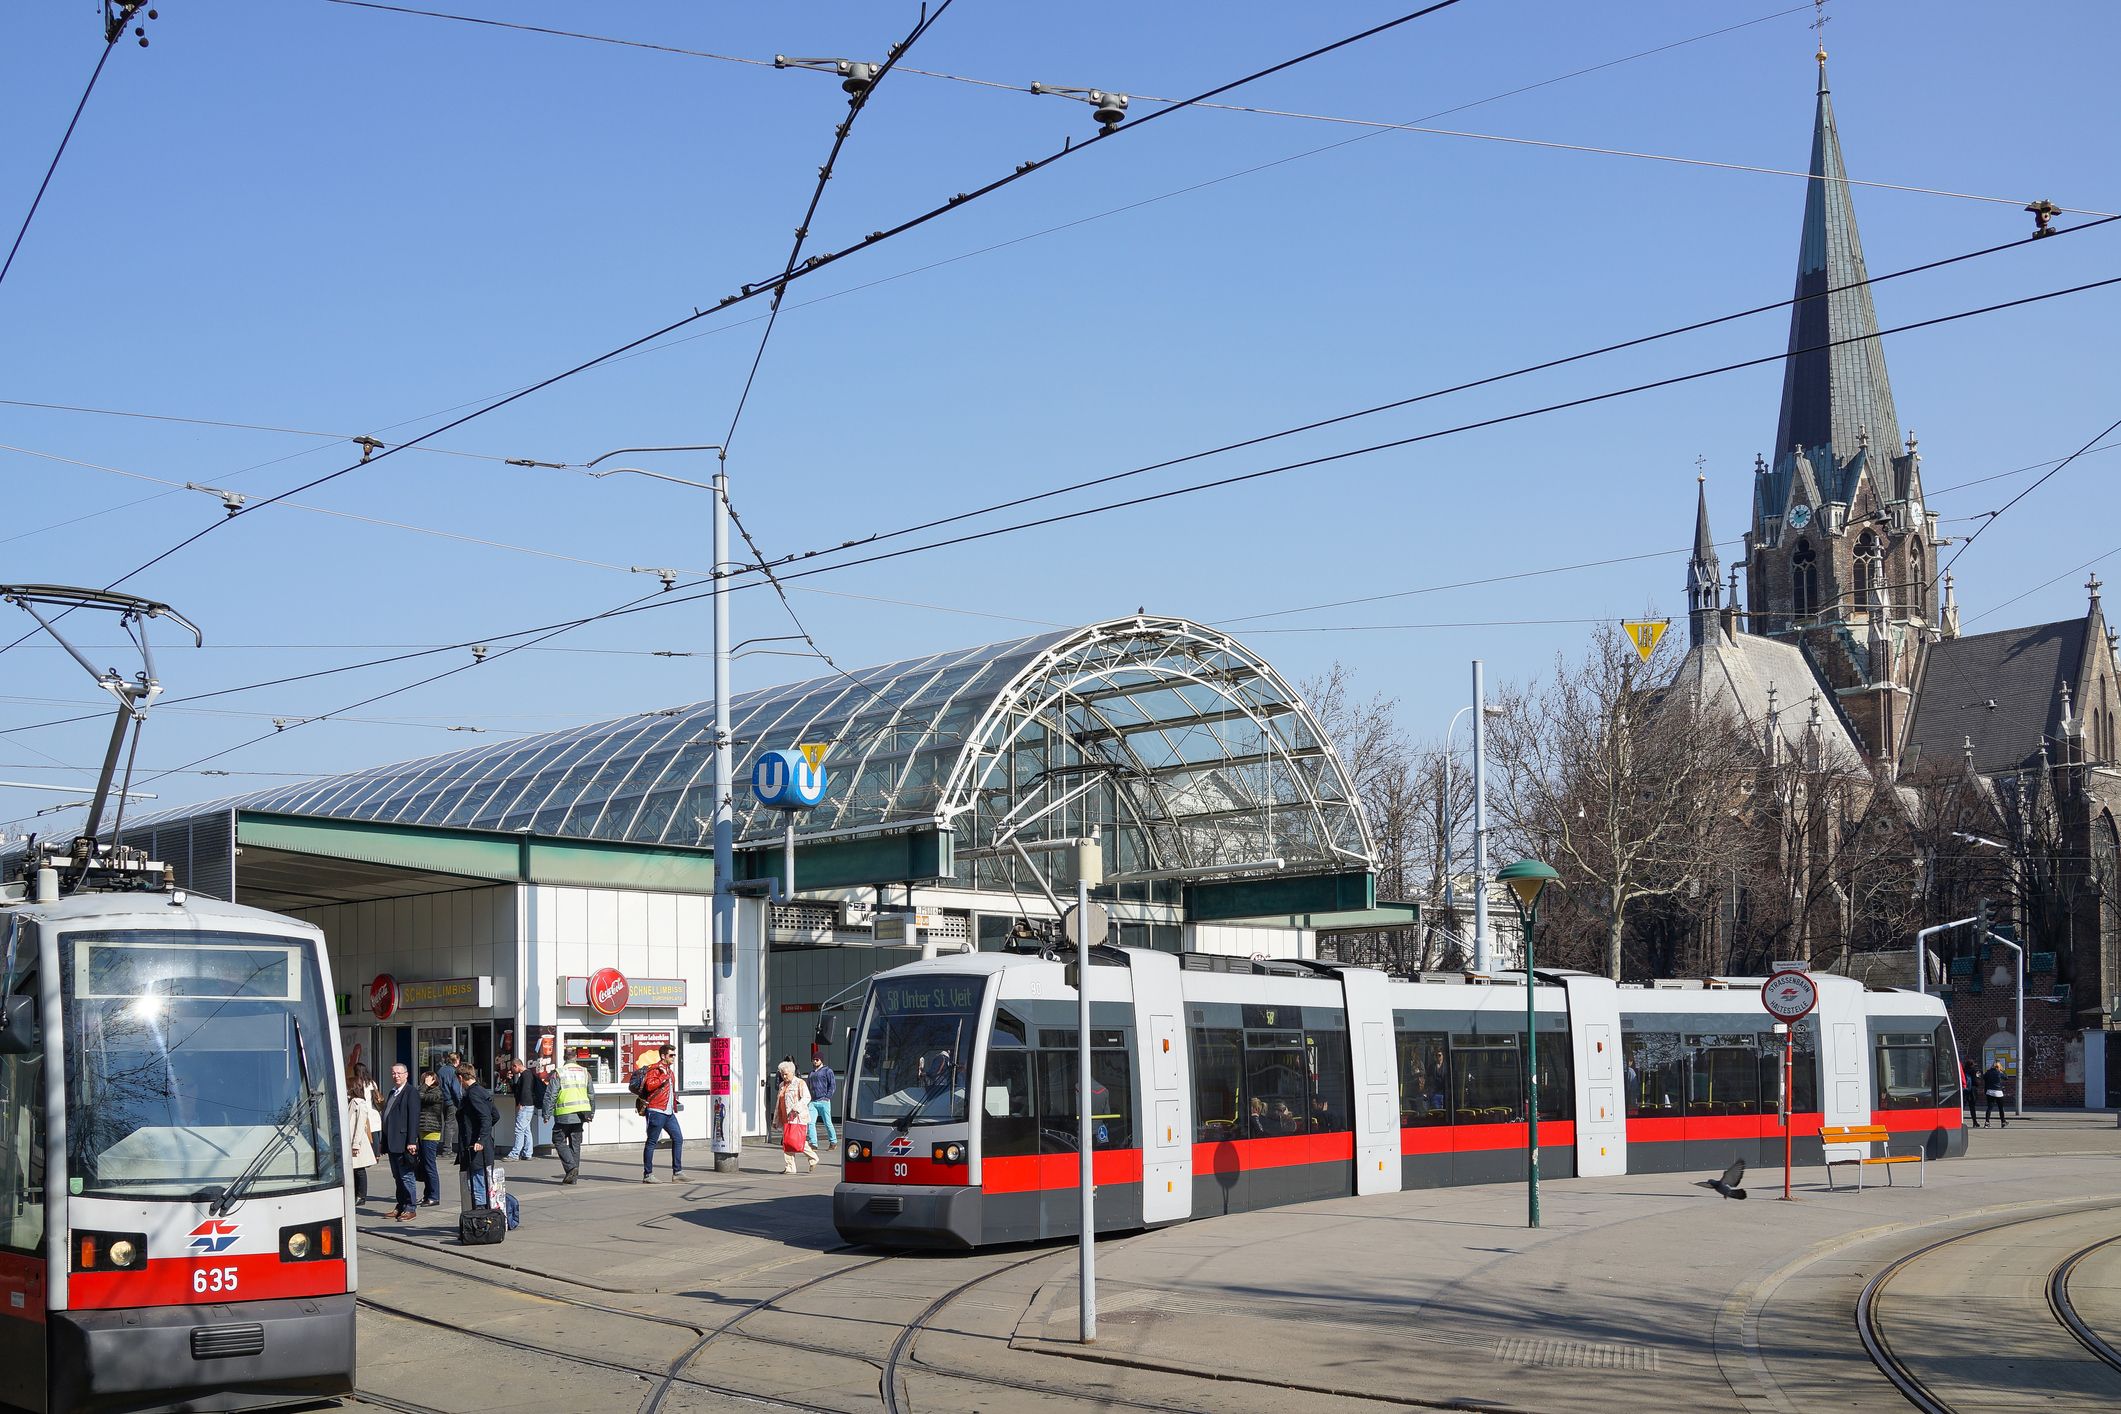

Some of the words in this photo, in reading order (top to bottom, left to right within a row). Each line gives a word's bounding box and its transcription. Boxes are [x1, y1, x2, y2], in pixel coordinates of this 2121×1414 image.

[758, 762, 783, 799] U
[799, 763, 822, 800] U
[404, 983, 472, 1003] SCHNELLIMBISS
[629, 985, 684, 997] SCHNELLIMBISS
[1031, 982, 1043, 995] 90
[1768, 976, 1812, 994] STRASSENBAHN
[887, 991, 899, 1011] 58
[902, 990, 931, 1009] Unter
[933, 989, 949, 1008] St.
[950, 988, 972, 1007] Veit
[1769, 1000, 1809, 1015] HALTESTELLE
[894, 1163, 908, 1177] 90
[193, 1266, 239, 1293] 635
